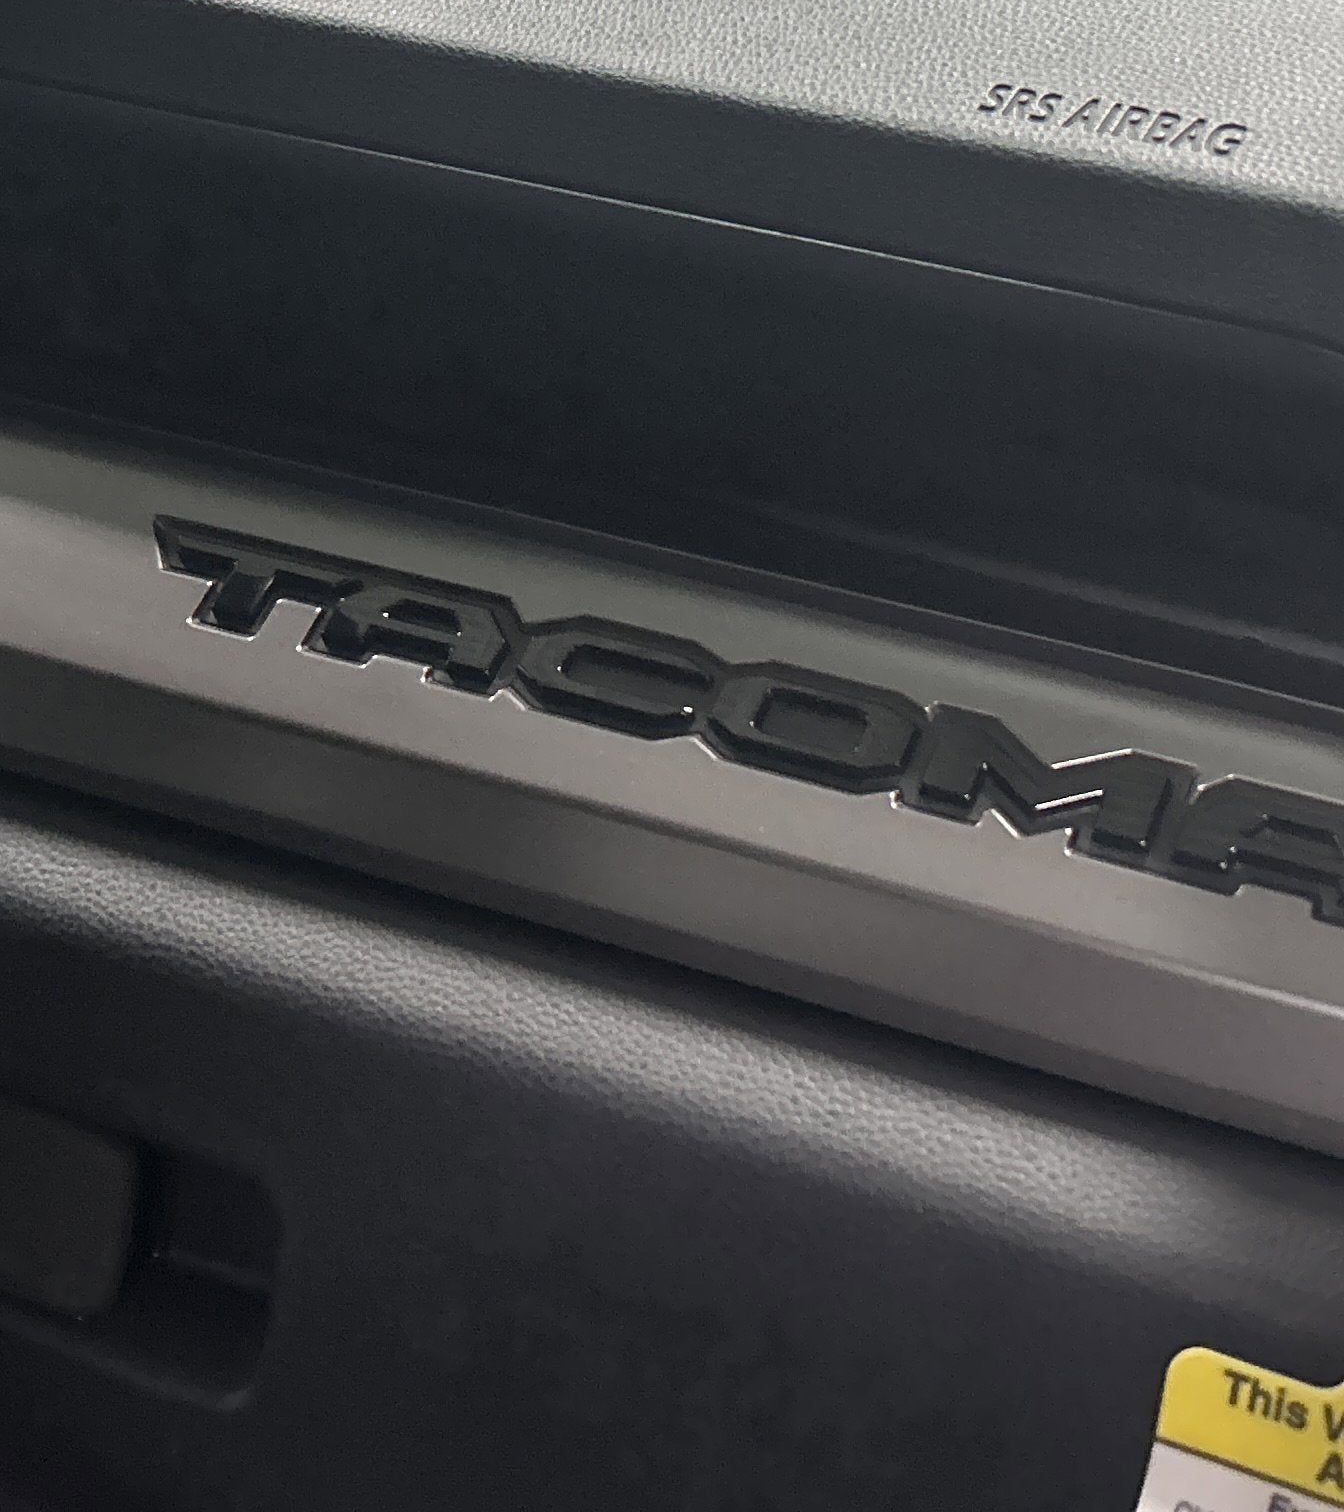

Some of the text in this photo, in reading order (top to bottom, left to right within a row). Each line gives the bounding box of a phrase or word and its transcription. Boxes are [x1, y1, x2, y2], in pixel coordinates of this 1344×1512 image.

[976, 83, 1249, 156] SRS AIRBAG
[1223, 1368, 1309, 1431] This
